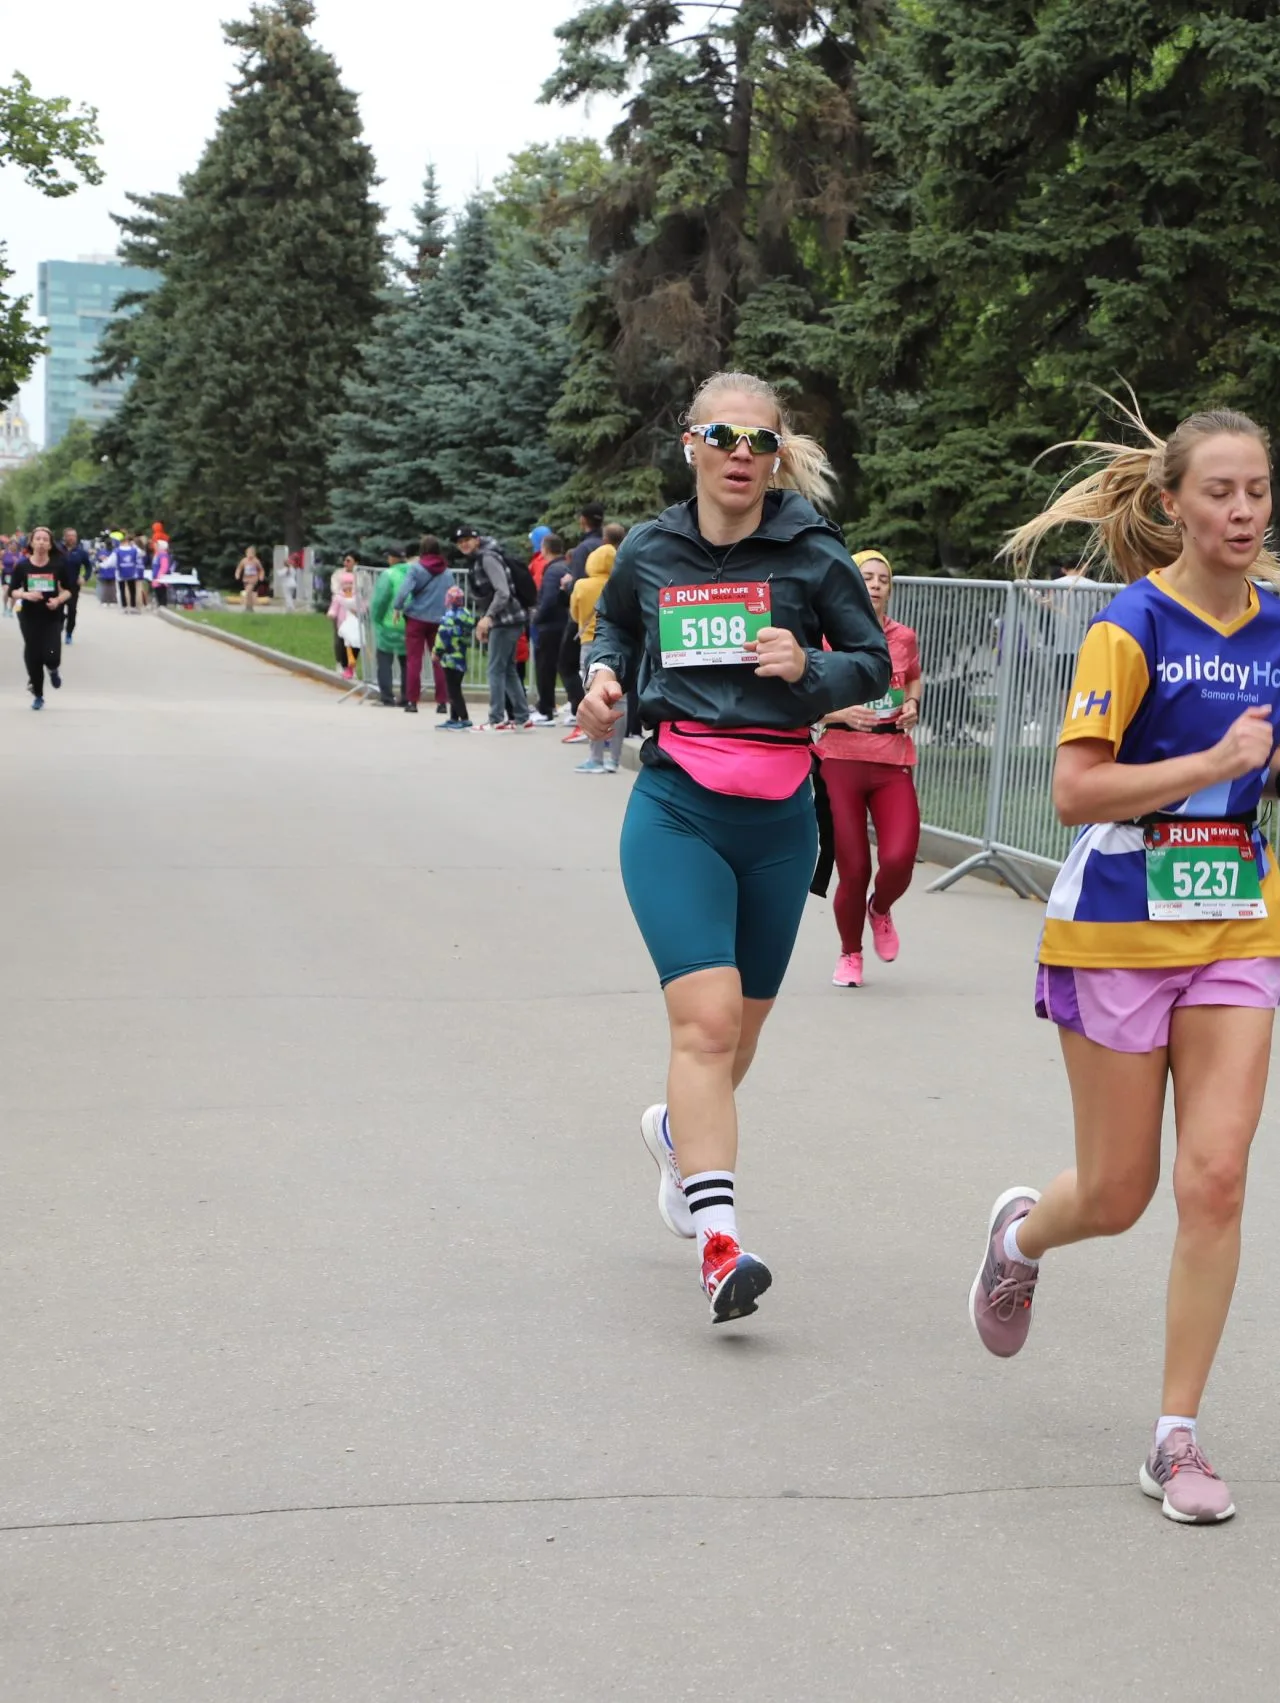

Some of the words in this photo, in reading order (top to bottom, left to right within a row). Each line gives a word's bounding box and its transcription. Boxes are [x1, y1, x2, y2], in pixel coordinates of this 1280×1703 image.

[676, 588, 709, 603] RUN
[733, 586, 749, 594] LIFE
[681, 616, 747, 648] 5198
[1201, 688, 1235, 701] Samara
[1237, 691, 1259, 704] Hotel
[1169, 827, 1210, 843] RUN
[1211, 827, 1218, 835] IS
[1219, 827, 1228, 835] MY
[1172, 860, 1239, 898] 5237
